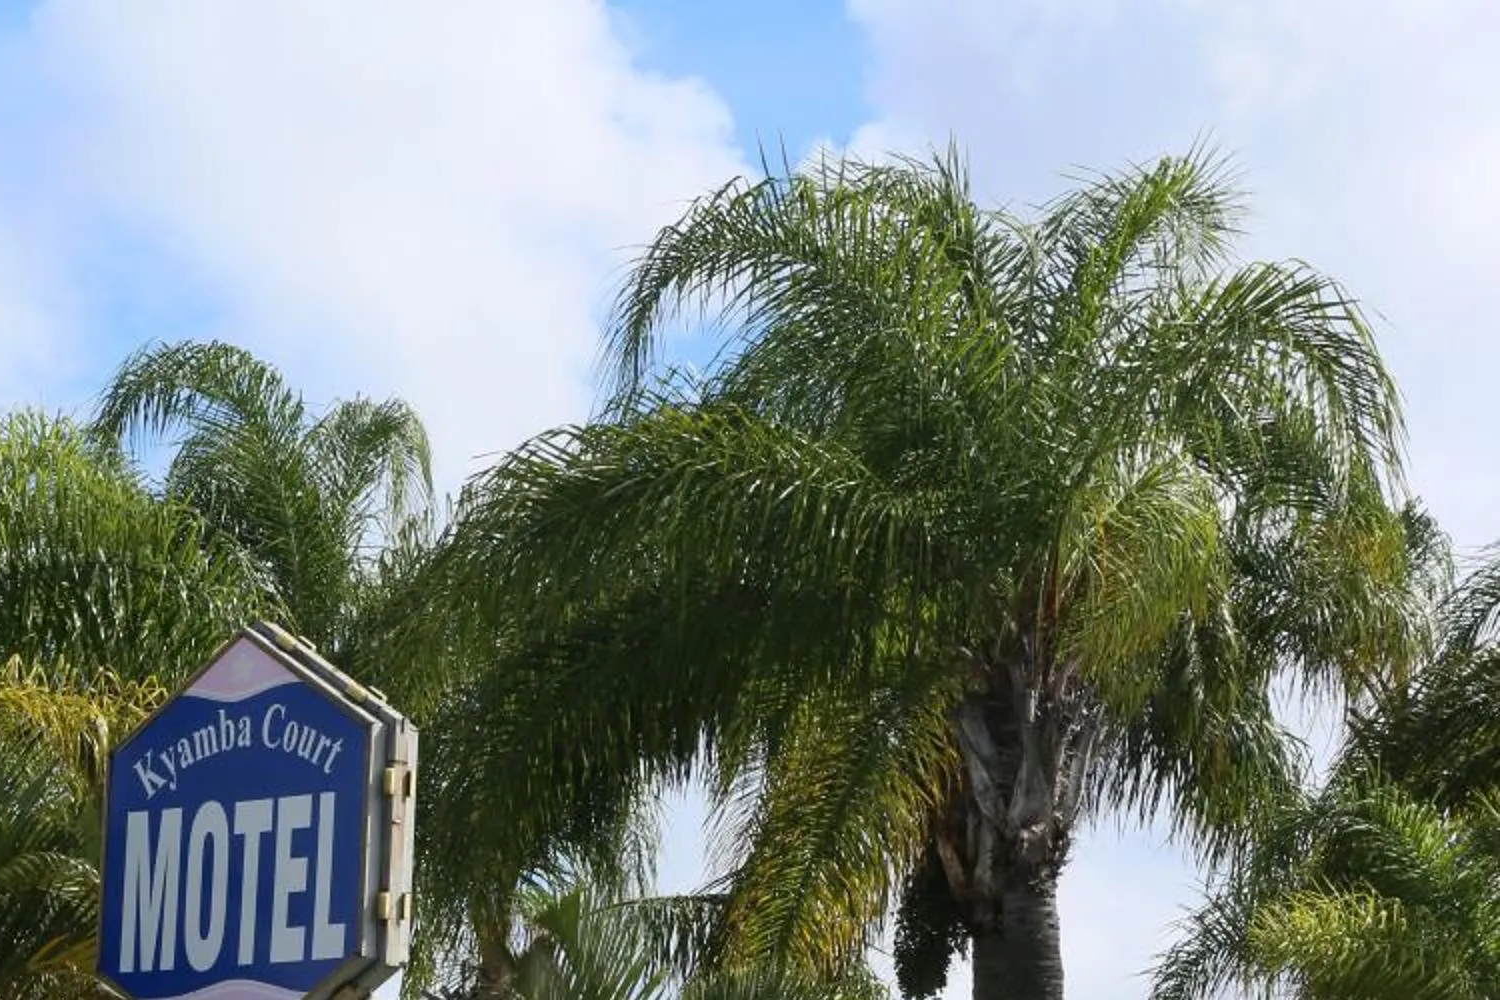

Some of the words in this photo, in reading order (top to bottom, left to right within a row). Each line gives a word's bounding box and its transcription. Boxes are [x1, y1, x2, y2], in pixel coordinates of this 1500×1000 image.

[134, 709, 252, 799] Kyamba
[262, 703, 343, 774] Court
[119, 791, 346, 974] MOTEL
